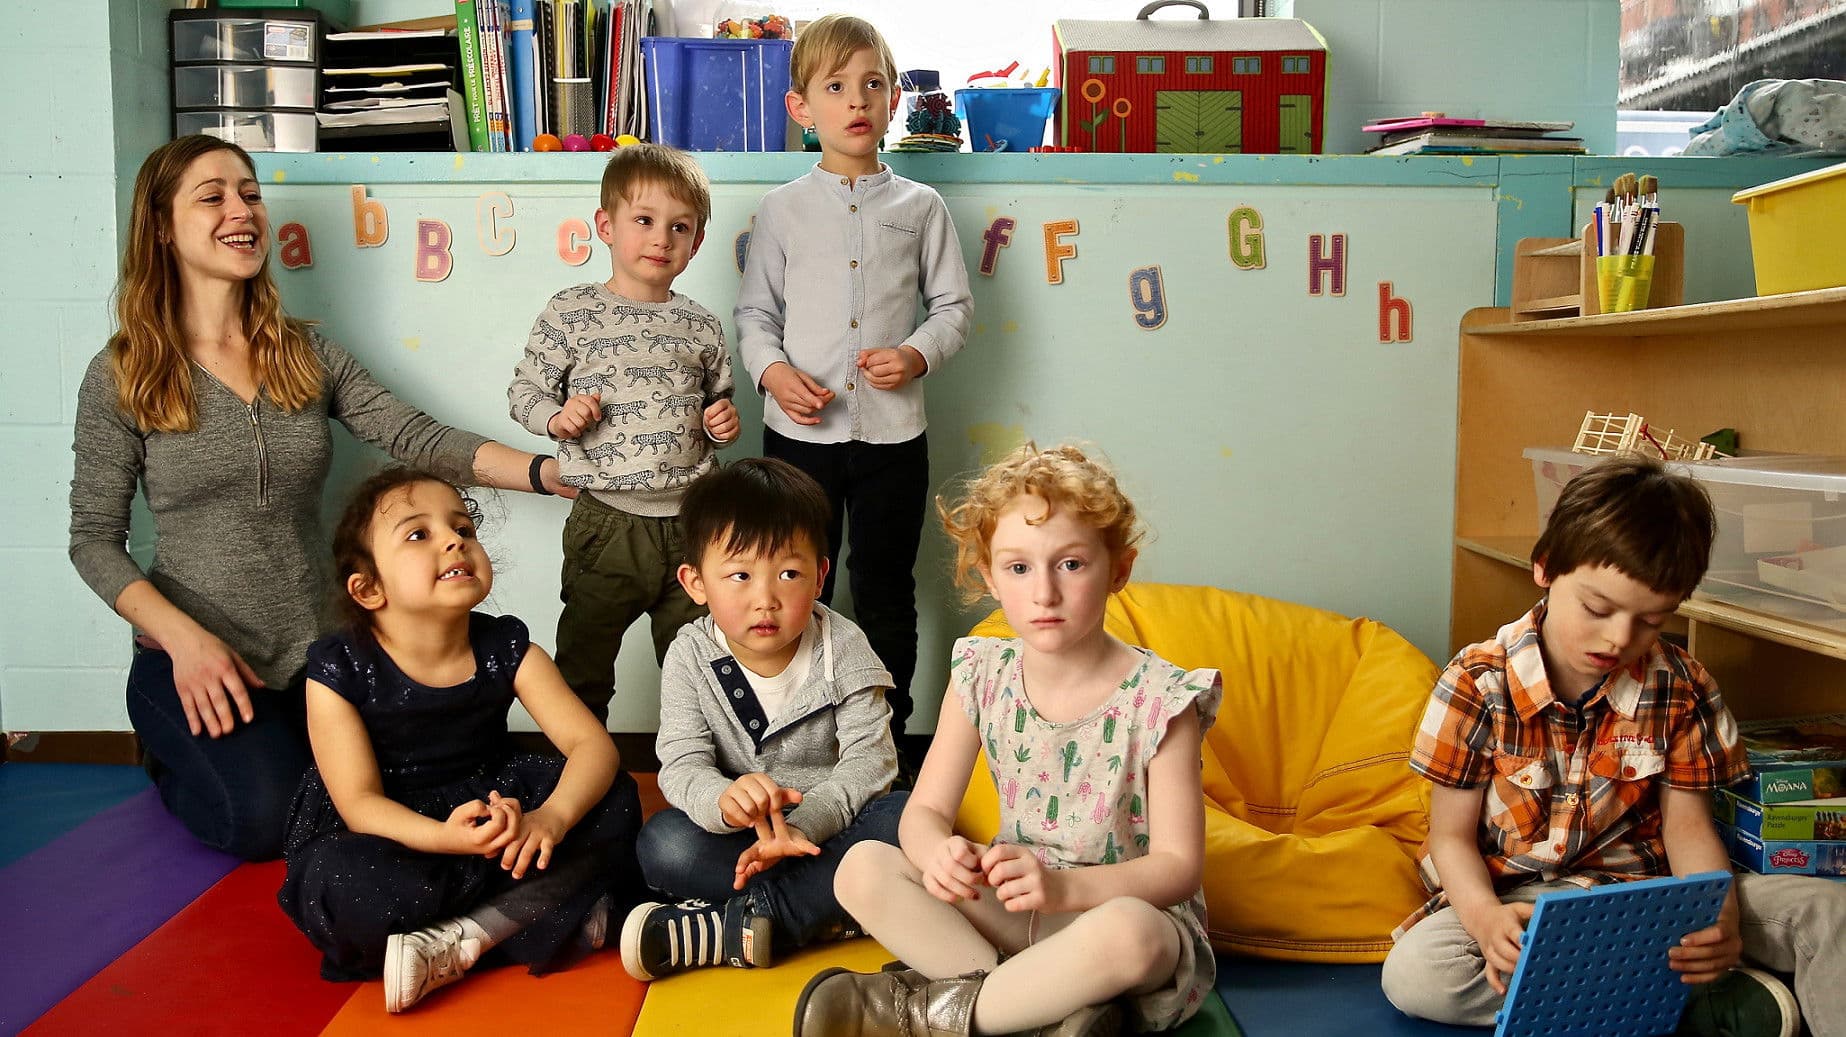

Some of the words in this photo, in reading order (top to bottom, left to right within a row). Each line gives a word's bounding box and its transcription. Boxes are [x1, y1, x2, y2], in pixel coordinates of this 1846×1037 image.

[464, 26, 475, 78] PRÉSCOLAIRE
[471, 102, 480, 123] PRÊT
[279, 223, 312, 268] a
[353, 185, 388, 248] b
[477, 191, 516, 256] C
[556, 219, 592, 266] c
[978, 216, 1017, 276] f
[1228, 206, 1267, 270] G
[415, 218, 453, 282] B
[1042, 217, 1081, 286] F
[1307, 232, 1348, 297] H
[1129, 264, 1169, 331] g
[1377, 281, 1413, 343] h
[1766, 781, 1807, 793] MOANA
